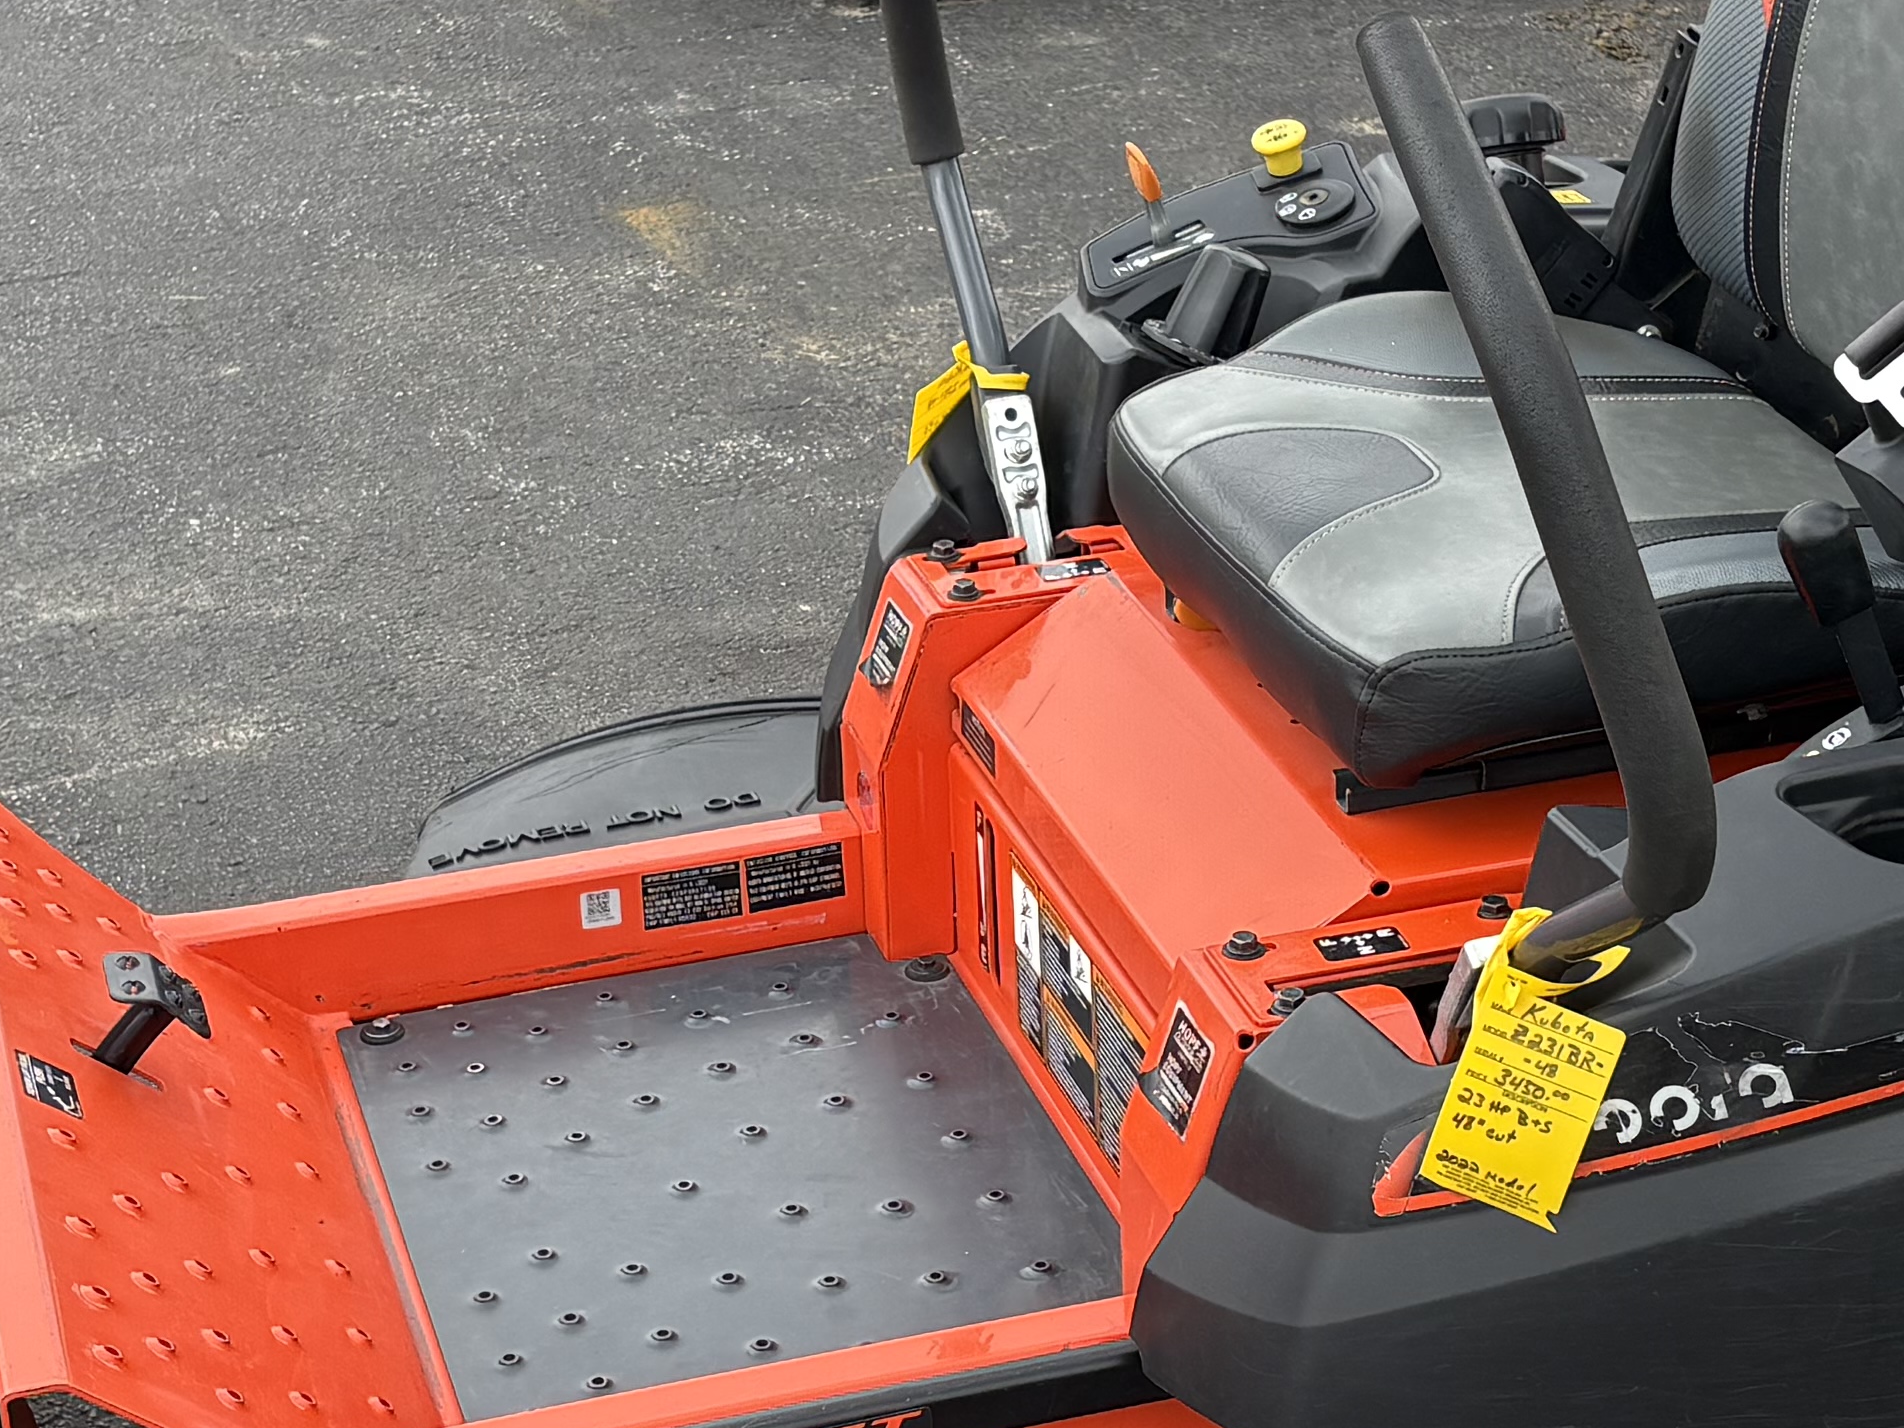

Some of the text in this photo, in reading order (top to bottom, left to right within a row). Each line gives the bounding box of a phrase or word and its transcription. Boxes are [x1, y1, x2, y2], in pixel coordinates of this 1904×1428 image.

[428, 791, 762, 872] DO NOT REMOVE
[1457, 1087, 1486, 1109] 23
[1485, 1126, 1518, 1144] cut
[1435, 1149, 1480, 1175] 2022
